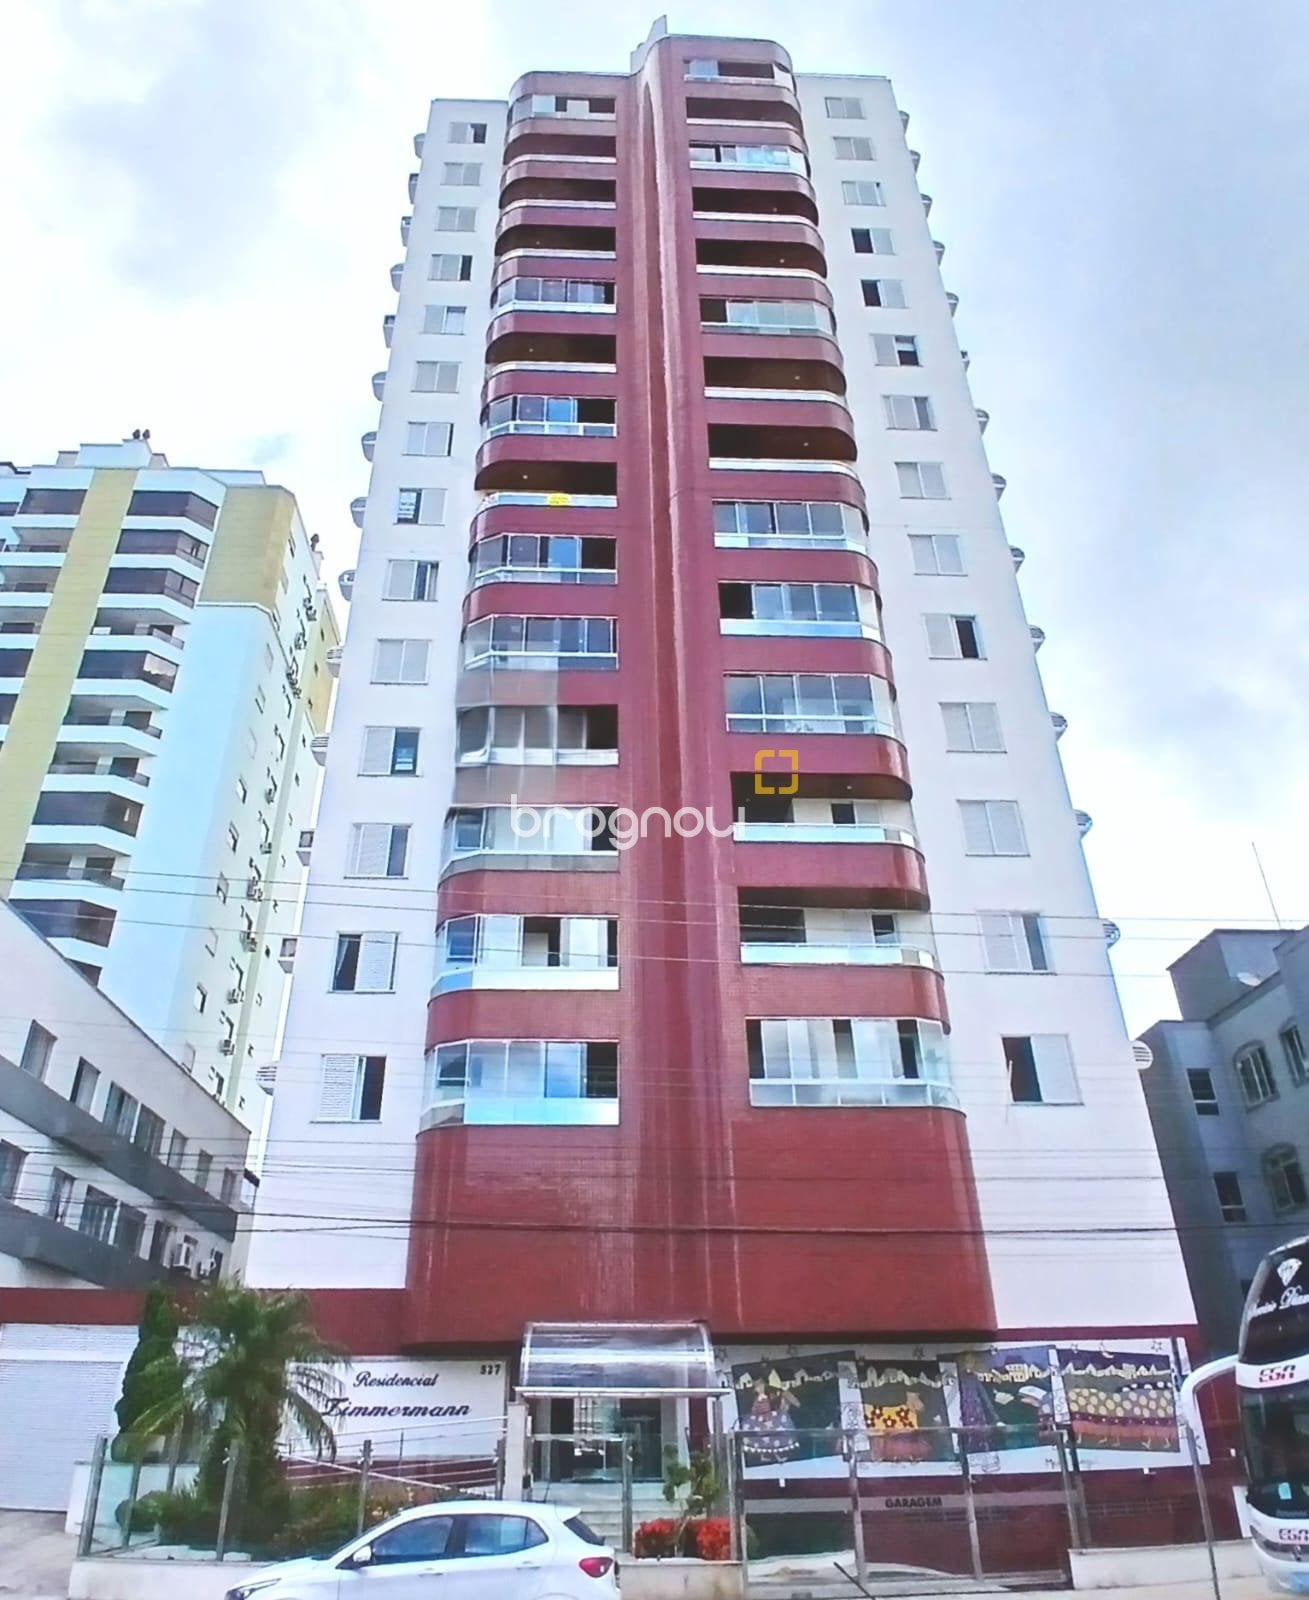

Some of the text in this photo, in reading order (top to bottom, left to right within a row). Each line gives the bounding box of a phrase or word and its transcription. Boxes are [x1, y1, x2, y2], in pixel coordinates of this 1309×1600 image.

[353, 1371, 440, 1388] Residencial
[322, 1397, 470, 1417] Zimmermann
[885, 1496, 943, 1509] GARAGEM
